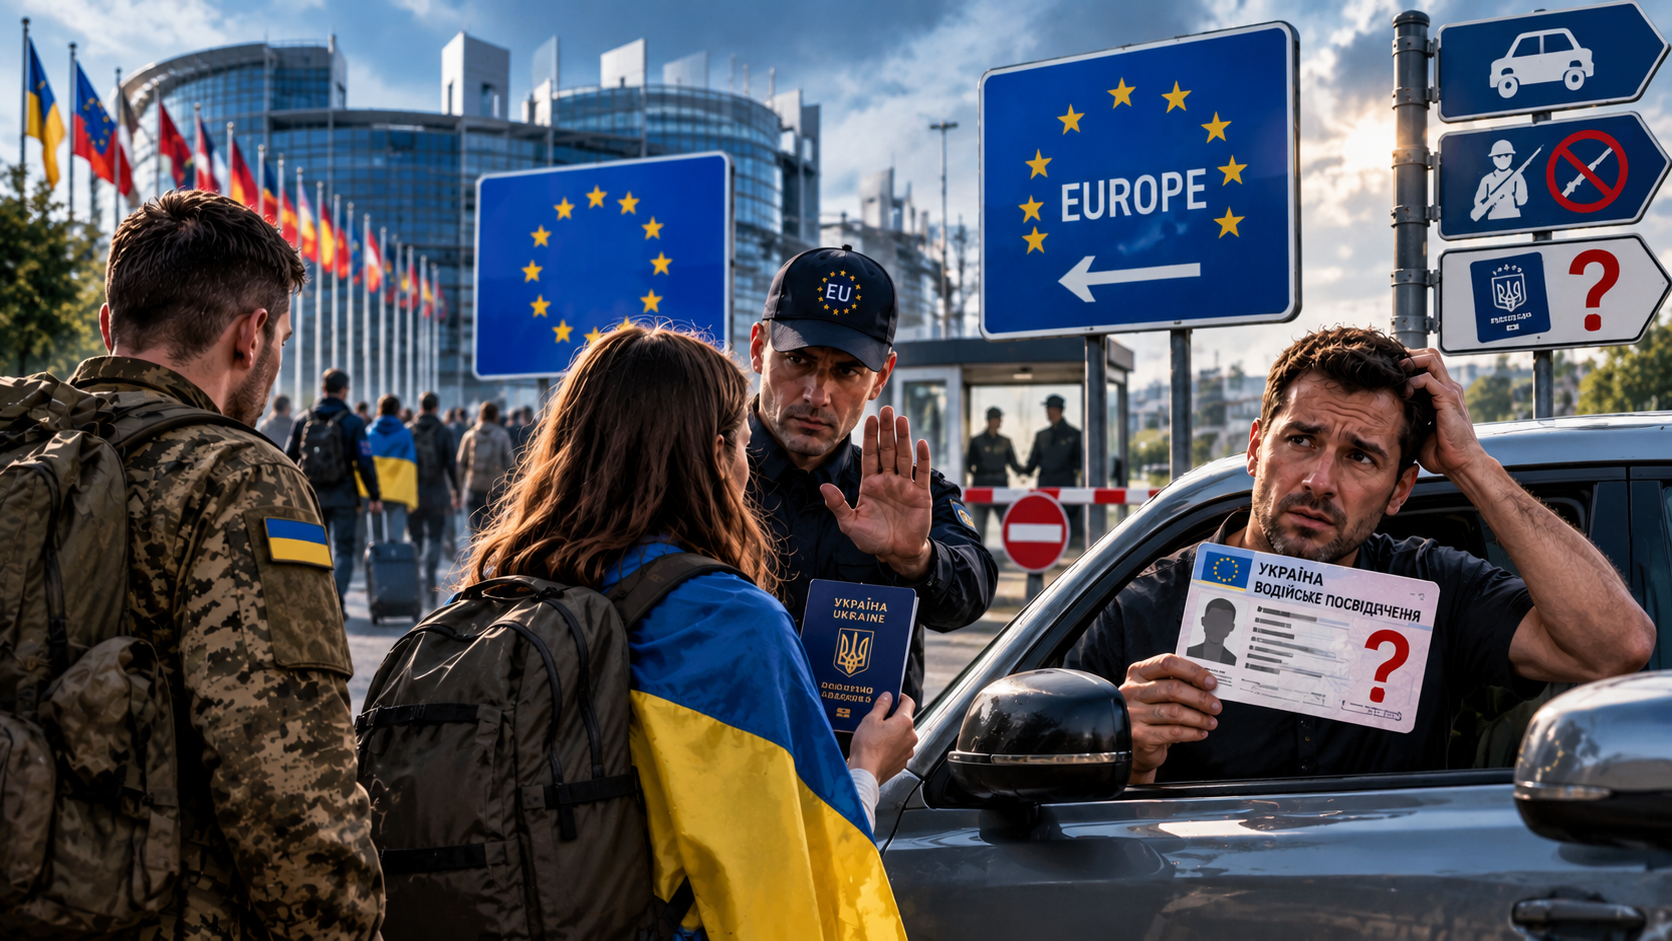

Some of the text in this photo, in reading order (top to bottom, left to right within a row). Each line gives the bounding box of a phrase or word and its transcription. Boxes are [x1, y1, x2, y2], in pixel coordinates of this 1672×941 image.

[1062, 168, 1207, 222] EUROPE
[826, 283, 852, 302] EU
[1569, 249, 1620, 332] ?
[1258, 562, 1324, 586] УКРАЇНА
[834, 597, 888, 612] УКРАЇНА
[1254, 581, 1323, 605] ВОДІЙСЬКЕ
[833, 610, 886, 624] UKRAINE
[1364, 629, 1410, 703] ?
